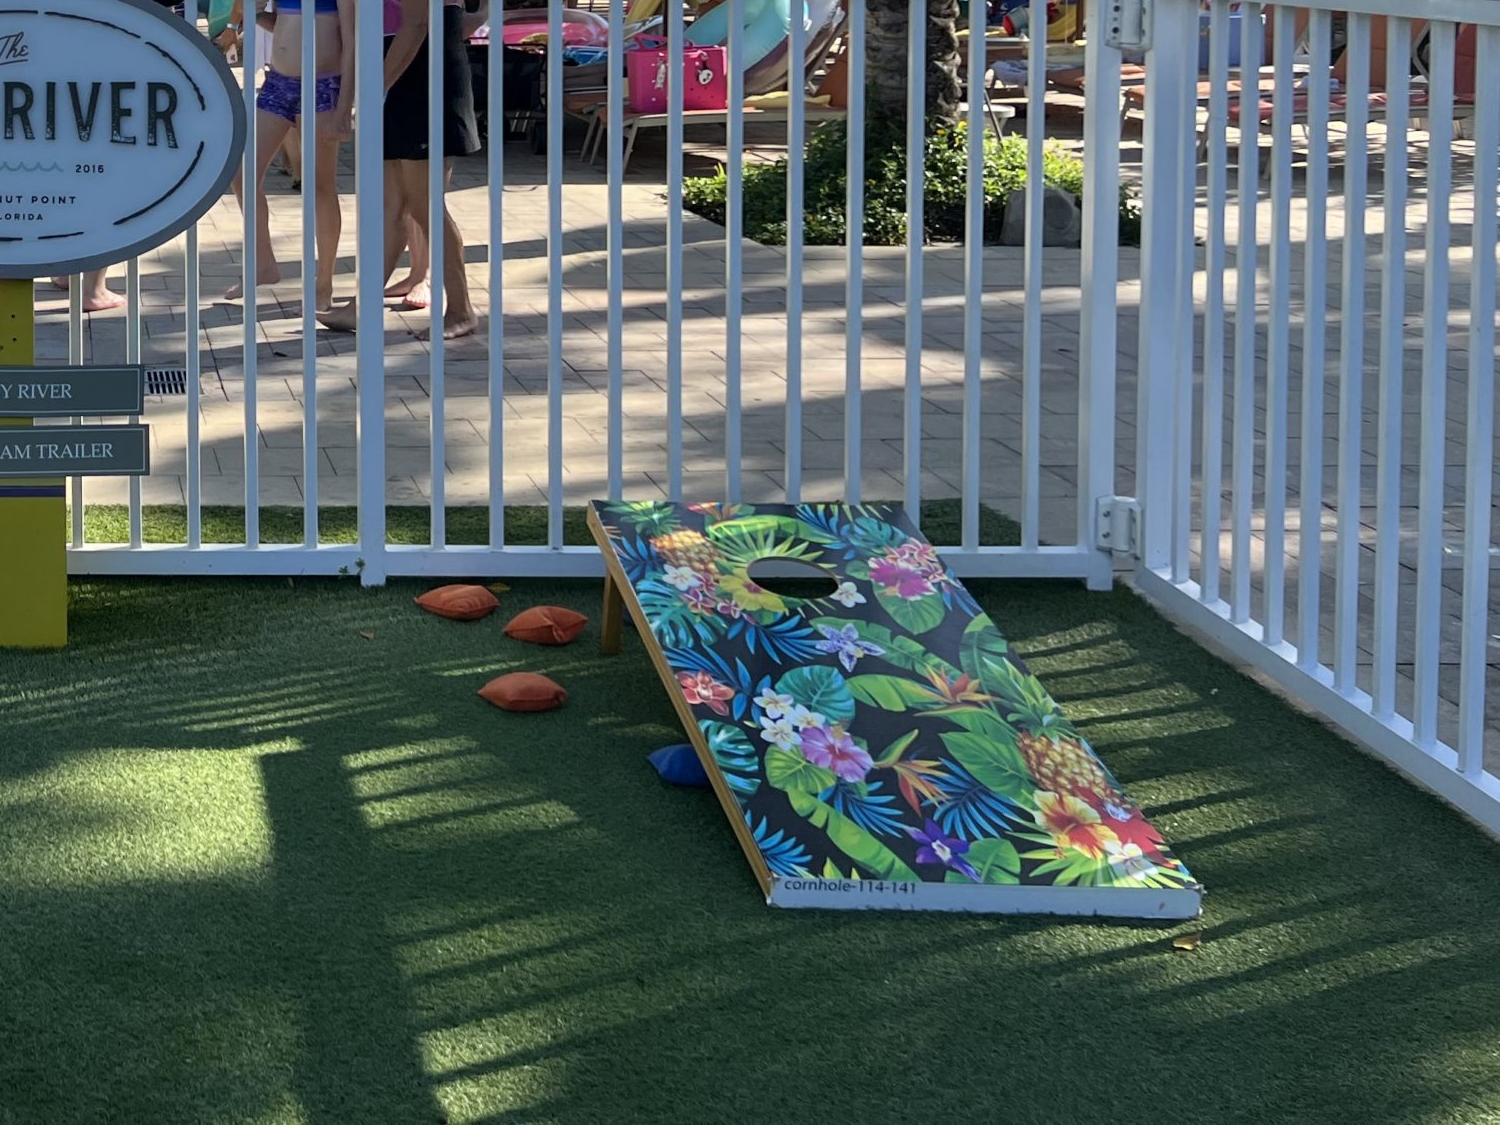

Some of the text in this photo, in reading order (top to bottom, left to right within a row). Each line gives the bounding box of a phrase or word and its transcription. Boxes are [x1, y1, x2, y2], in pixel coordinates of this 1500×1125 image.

[31, 195, 77, 205] POINT
[18, 383, 72, 399] RIVER
[36, 443, 114, 459] TRAILER
[784, 877, 916, 894] cornhole-114-141
